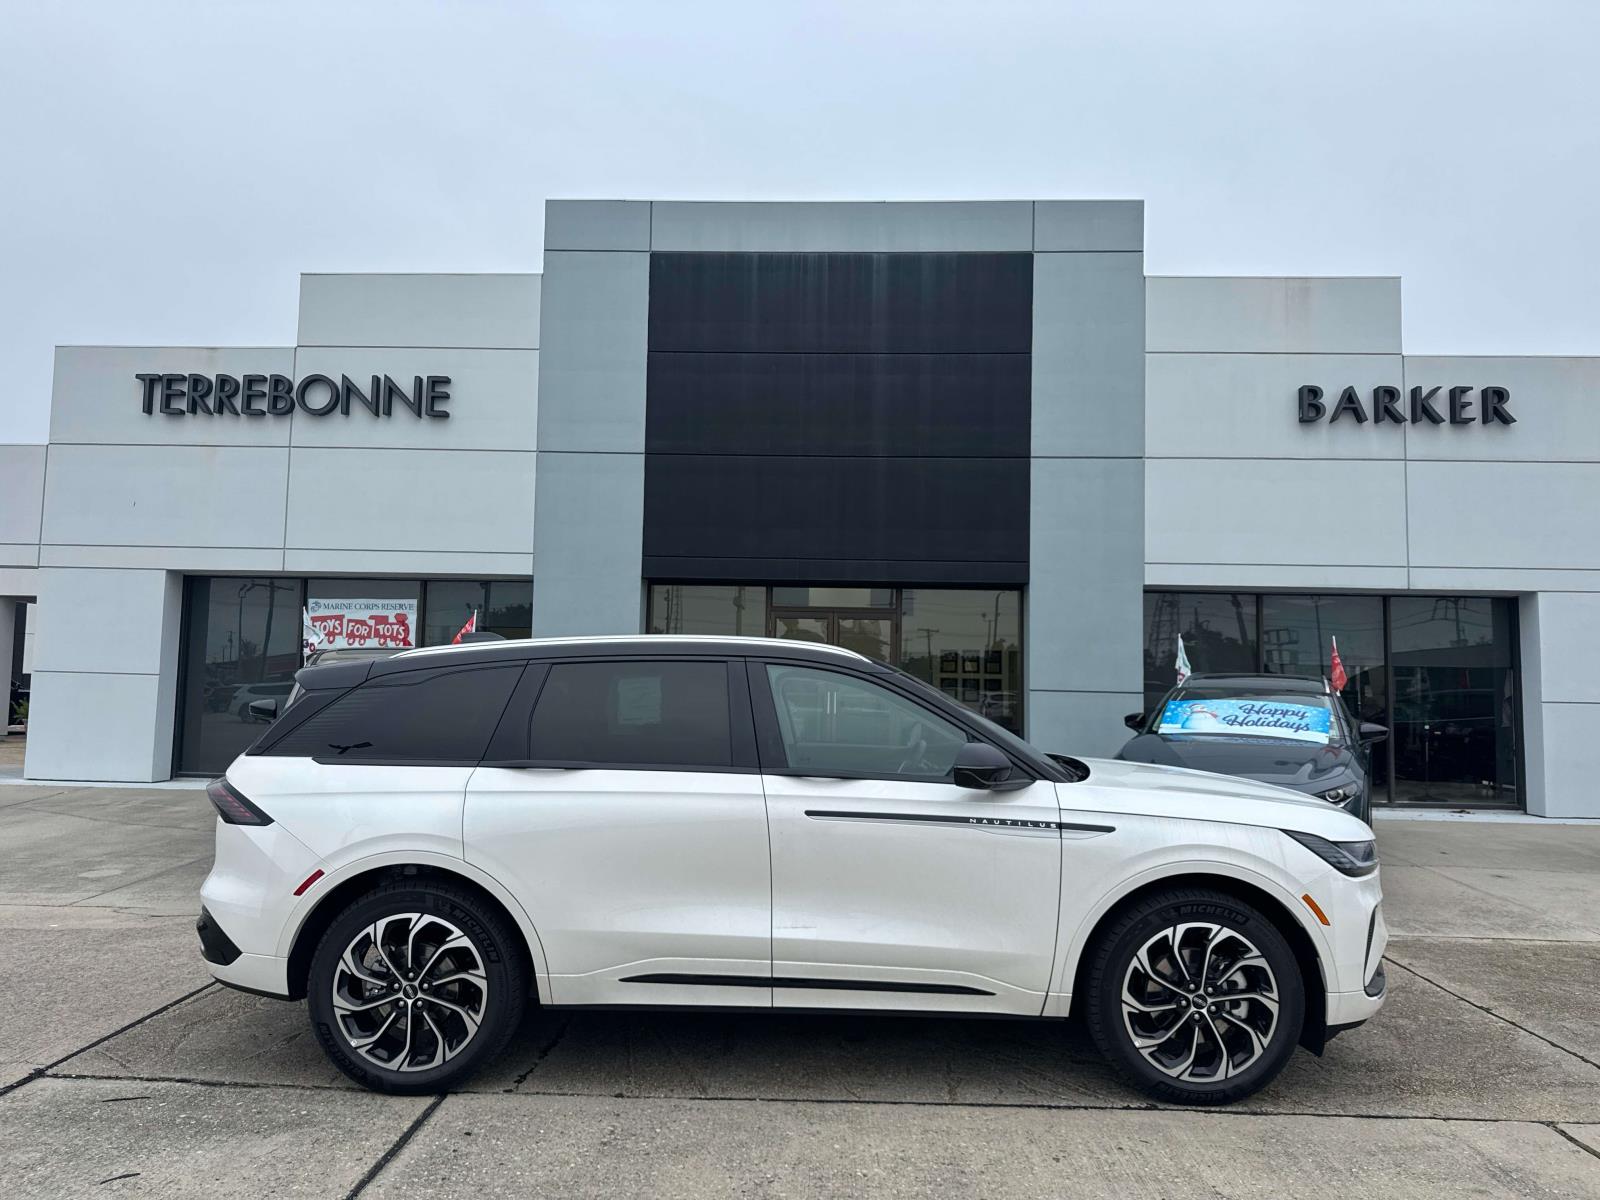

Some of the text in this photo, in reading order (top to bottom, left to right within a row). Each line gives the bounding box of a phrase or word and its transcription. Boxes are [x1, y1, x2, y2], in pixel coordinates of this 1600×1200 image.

[135, 372, 451, 418] TERREBONNE
[1298, 384, 1517, 425] BARKER
[322, 602, 415, 611] MARINE CORPS RESERVE
[314, 619, 405, 638] TOYS FOR TOTS
[1239, 704, 1309, 720] Happy
[1222, 714, 1310, 733] Holidays
[969, 818, 1057, 829] NAUTILUS
[1179, 905, 1247, 924] MICHELIN
[452, 908, 498, 961] MICHELIN
